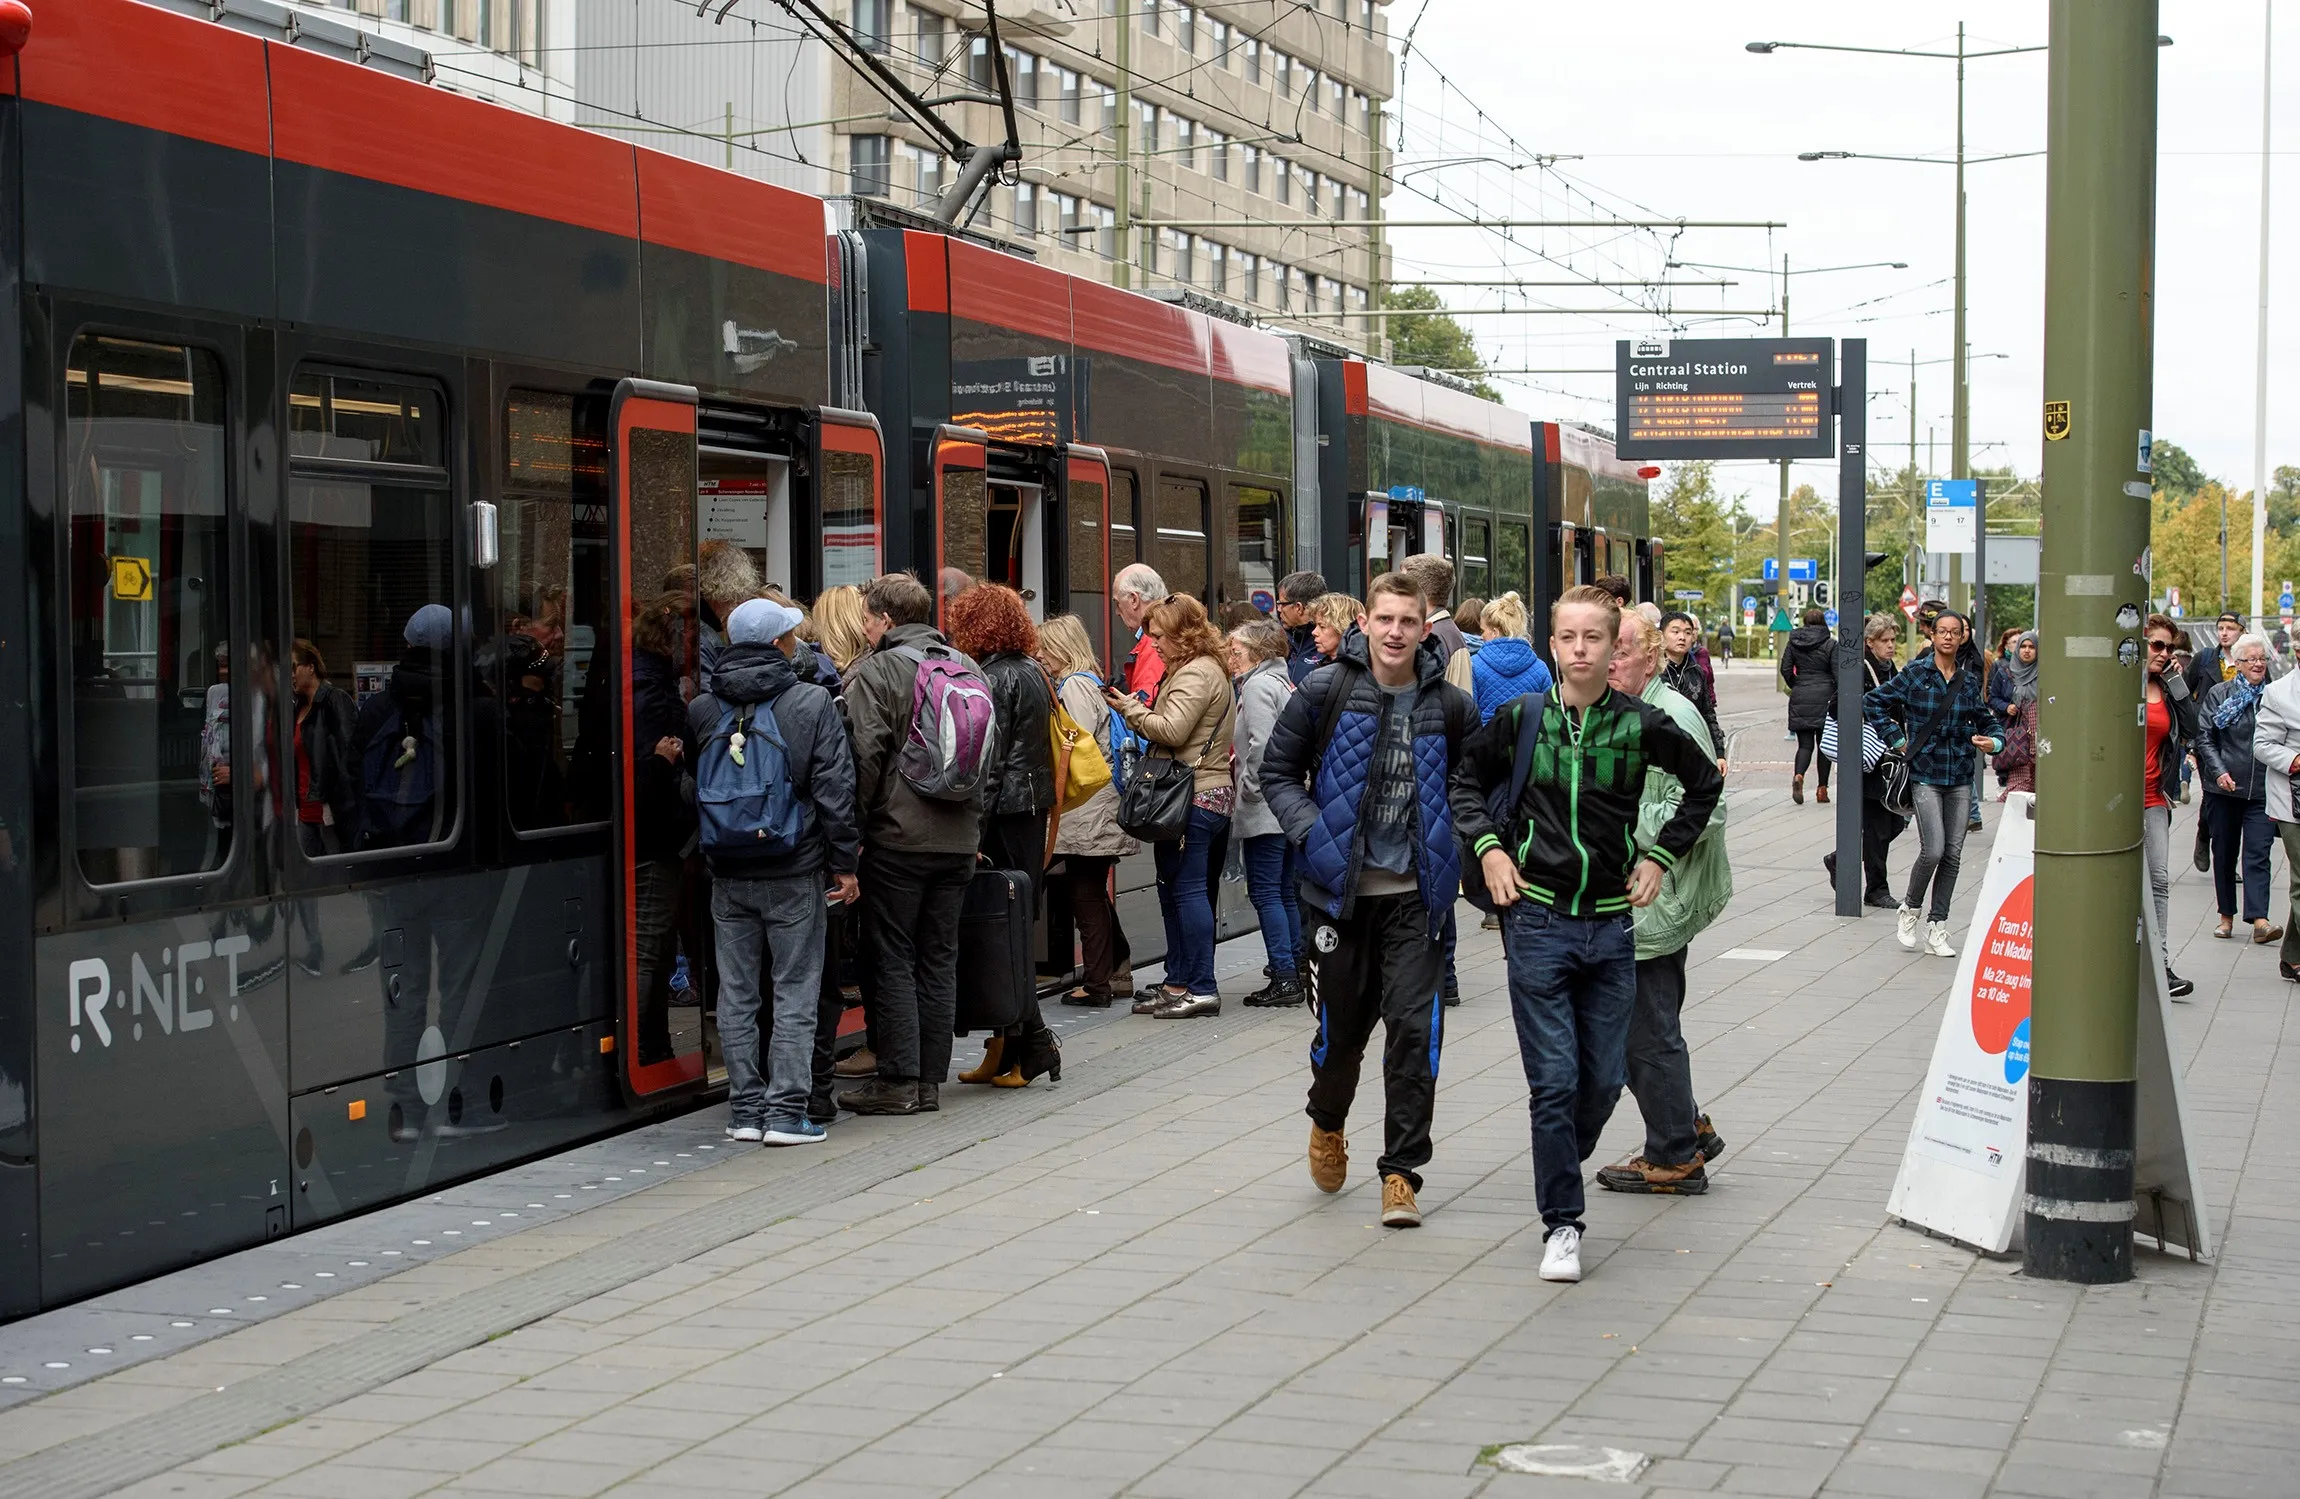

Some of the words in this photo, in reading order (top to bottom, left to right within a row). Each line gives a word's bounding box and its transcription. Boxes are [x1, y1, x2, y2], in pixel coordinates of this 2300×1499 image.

[1629, 363, 1690, 376] Centraal
[1694, 362, 1748, 375] Station
[1635, 382, 1650, 391] Lijn
[1656, 382, 1688, 391] Richting
[1787, 381, 1817, 389] Vertrek
[1931, 482, 1943, 497] E
[1997, 916, 2020, 936] Tram
[2020, 921, 2028, 937] 9
[1990, 939, 2005, 956] tot
[1982, 966, 1995, 982] Ma
[1994, 969, 2006, 983] 22
[2004, 974, 2019, 990] aug
[2018, 974, 2032, 989] t/m
[1977, 987, 1987, 999] za
[1987, 987, 1997, 1000] 10
[1995, 989, 2010, 1003] dec
